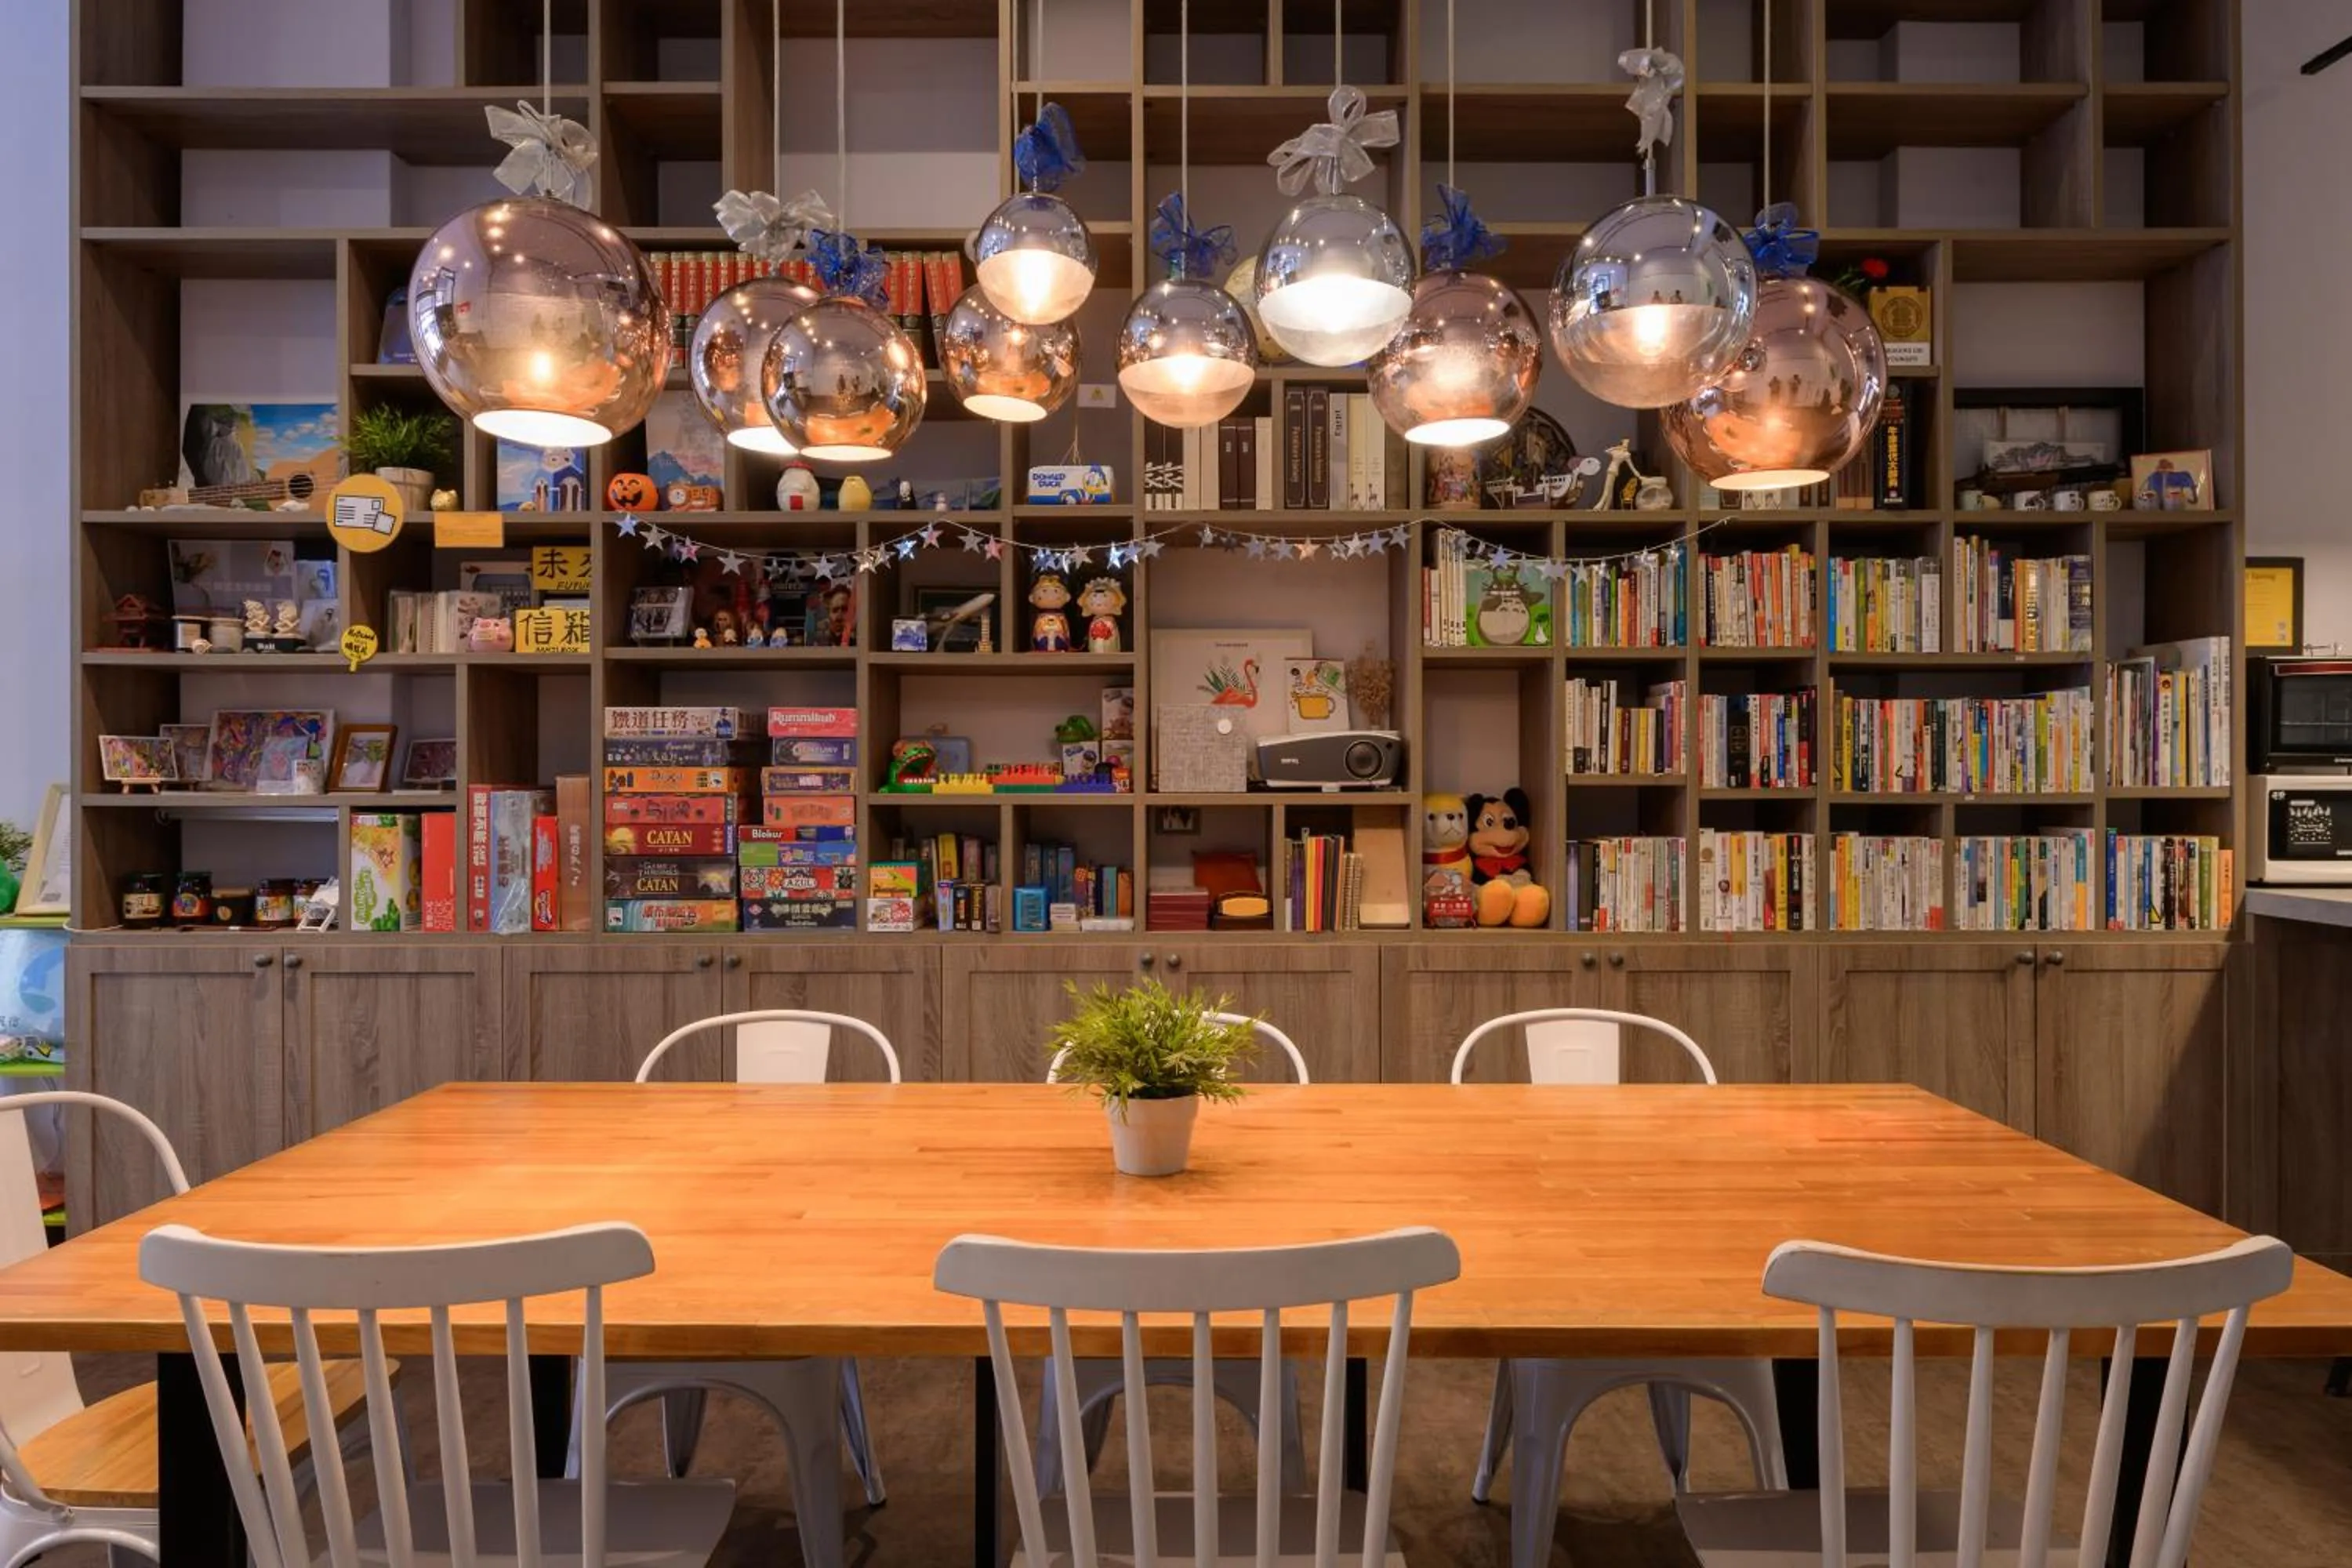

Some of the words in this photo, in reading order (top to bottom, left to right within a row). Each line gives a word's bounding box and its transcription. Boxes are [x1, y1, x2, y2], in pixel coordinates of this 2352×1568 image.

[518, 610, 590, 646] 信箱
[647, 829, 693, 845] CATAN
[637, 877, 679, 891] CATAN
